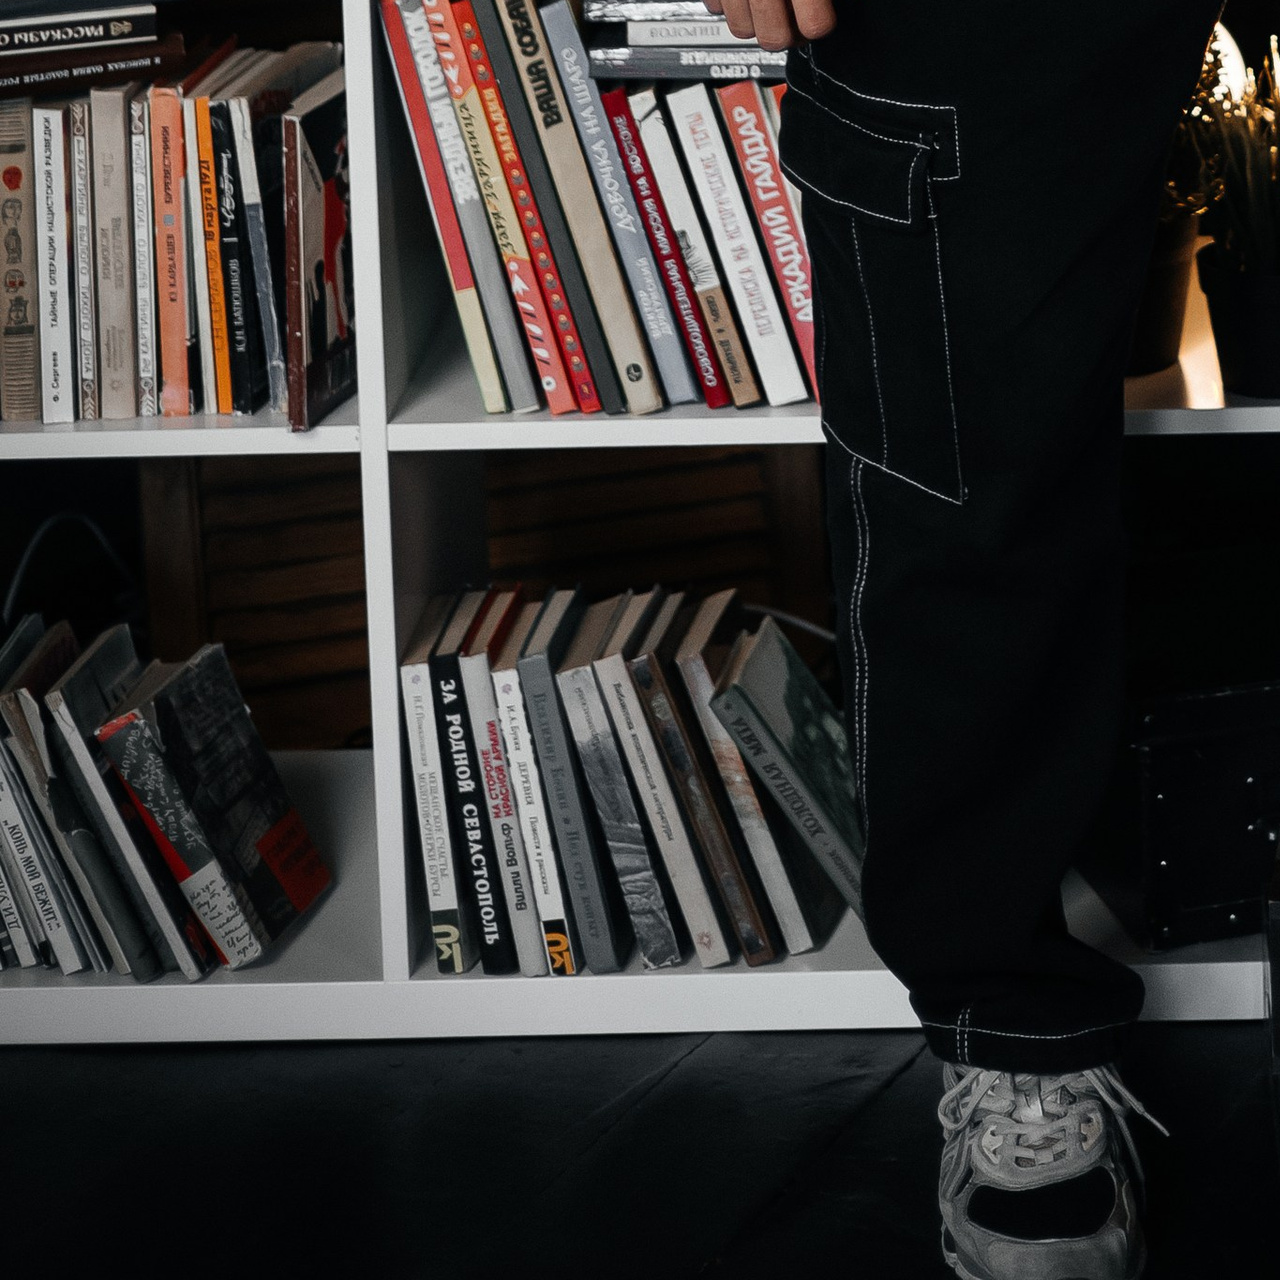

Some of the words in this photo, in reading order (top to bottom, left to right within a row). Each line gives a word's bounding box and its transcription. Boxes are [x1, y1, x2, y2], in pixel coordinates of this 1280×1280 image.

[13, 24, 104, 44] РАССКАЗЫ
[0, 76, 20, 86] РОГ
[524, 58, 563, 129] ВАША
[558, 44, 592, 106] ШАРЕ
[579, 104, 602, 136] НА
[612, 113, 644, 175] ВОСТОКЕ
[730, 102, 782, 203] ГАЙДАР
[588, 138, 638, 237] ДЕВОЧКА
[635, 175, 651, 197] НА
[642, 196, 672, 256] МИССИЯ
[730, 243, 750, 262] НА
[760, 204, 815, 325] АРКАДИЙ
[663, 257, 718, 388] ОСВОБОДИТЕЛЬНАЯ
[736, 265, 775, 339] ПЕРЕПИСКА
[439, 678, 458, 704] ЗА
[444, 711, 475, 793] РОДНОЙ
[485, 719, 502, 762] АРМИИ
[480, 748, 499, 800] СТОРОНЕ
[493, 764, 513, 817] КРАСНОЙ
[491, 803, 502, 819] НА
[19, 853, 41, 881] МОЙ
[498, 821, 520, 867] Вольф
[461, 802, 500, 945] СЕВАСТОПОЛЬ
[508, 869, 527, 911] Вилли
